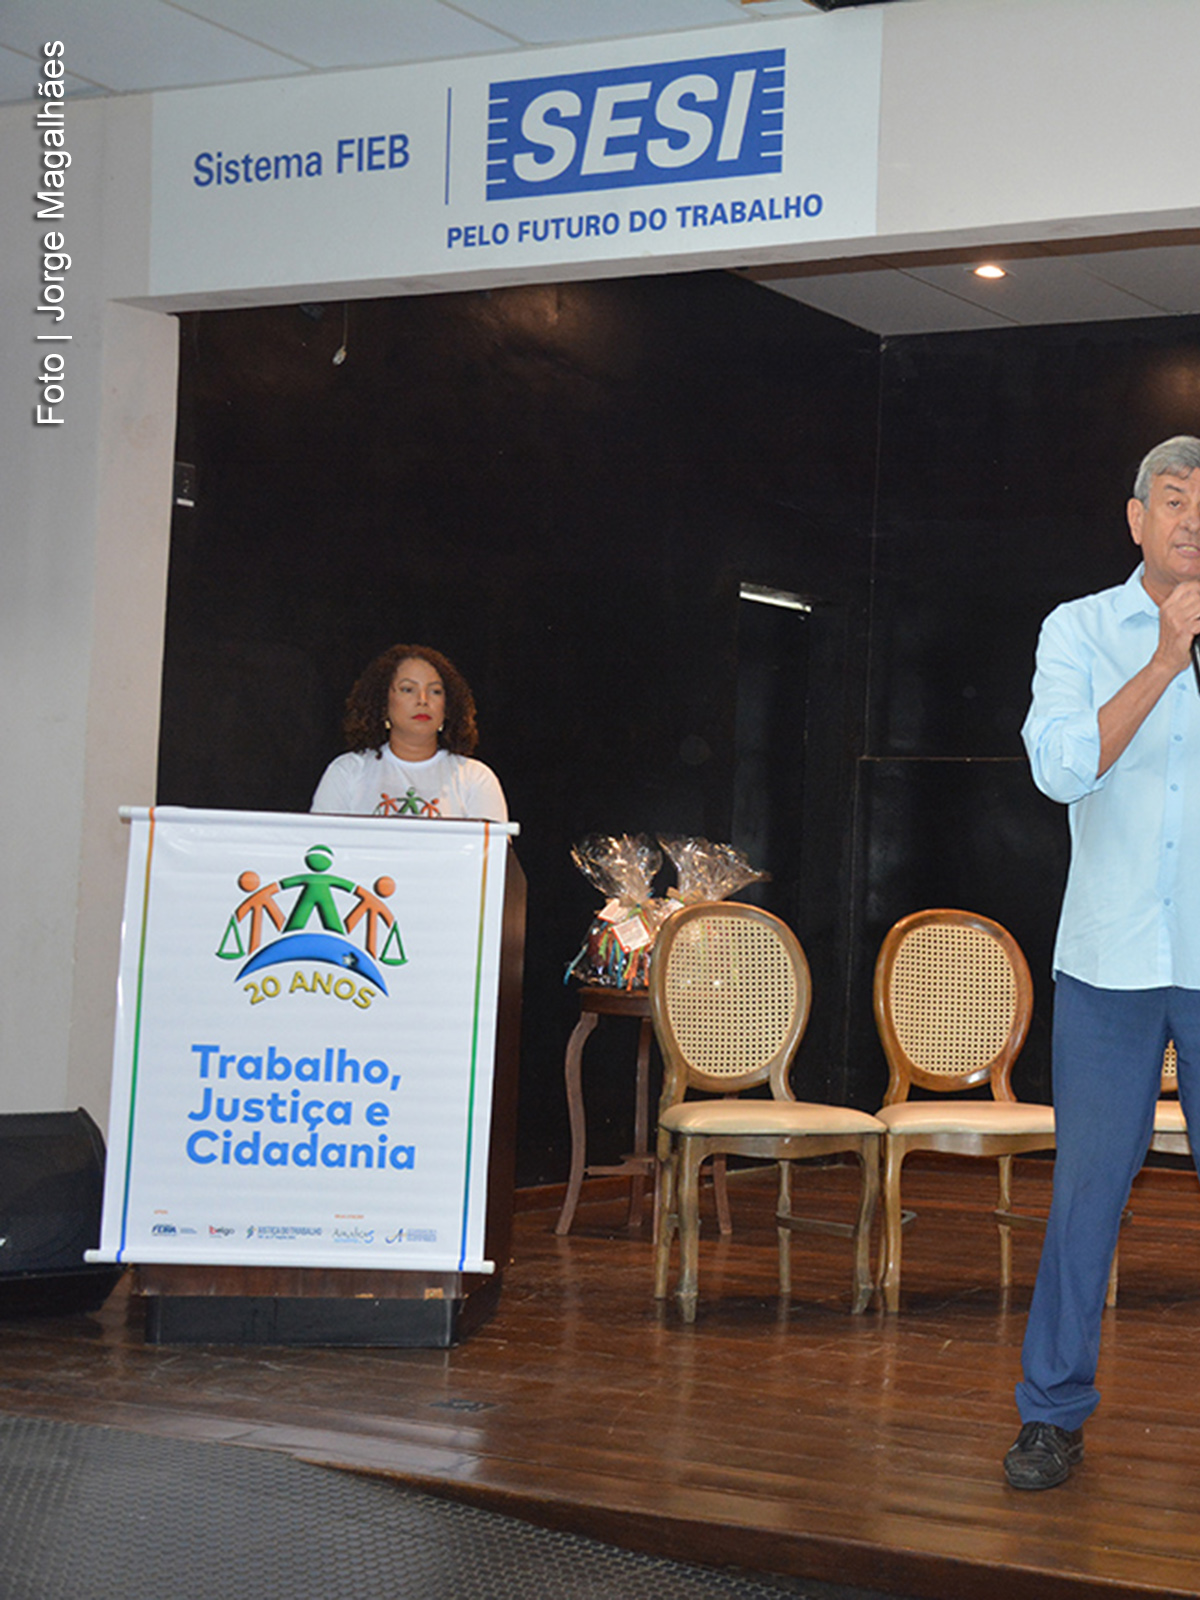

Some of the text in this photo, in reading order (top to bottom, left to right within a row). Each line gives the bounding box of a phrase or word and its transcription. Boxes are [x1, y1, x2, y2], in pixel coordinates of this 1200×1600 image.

[512, 68, 758, 183] SESI
[193, 132, 411, 188] Sistema FIEB
[446, 192, 825, 249] PELO FUTURO DO TRABALHO
[243, 970, 377, 1010] 20 ANOS
[190, 1043, 402, 1092] Trabalho,
[187, 1086, 391, 1133] Justiça e
[185, 1128, 417, 1171] Cidadania
